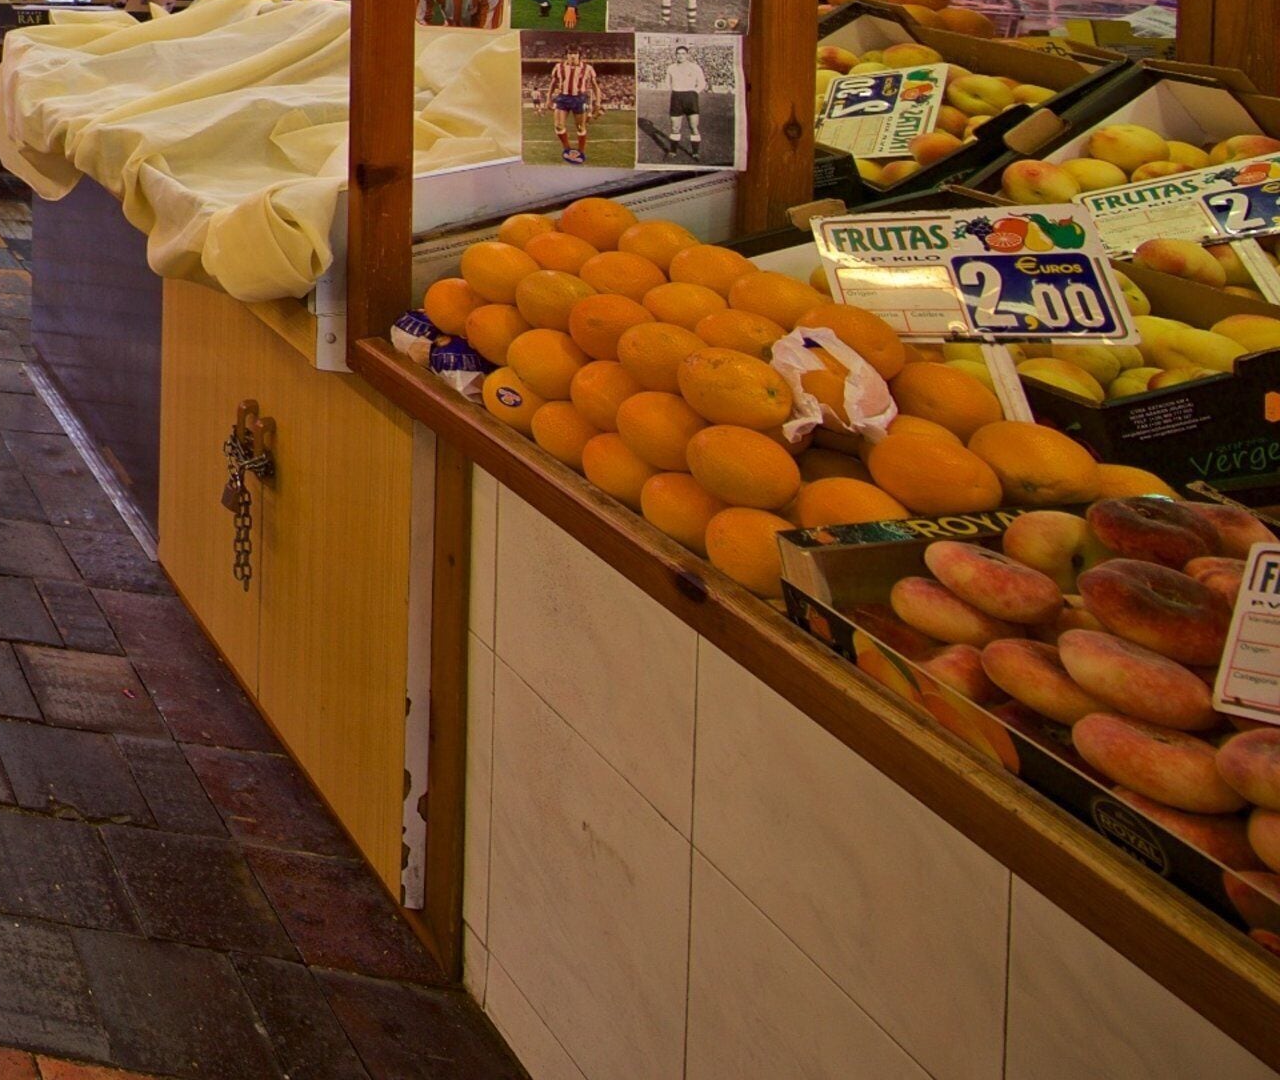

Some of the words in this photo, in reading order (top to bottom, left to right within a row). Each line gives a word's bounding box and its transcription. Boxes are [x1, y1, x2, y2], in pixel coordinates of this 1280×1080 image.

[18, 15, 42, 24] RAF
[1090, 178, 1201, 212] FRUTAS
[1209, 191, 1264, 234] 2
[831, 224, 950, 252] FRUTAS
[846, 289, 878, 298] Origen
[959, 261, 1107, 331] 2,00
[1240, 641, 1271, 655] Origen
[1098, 811, 1162, 865] ROYAL
